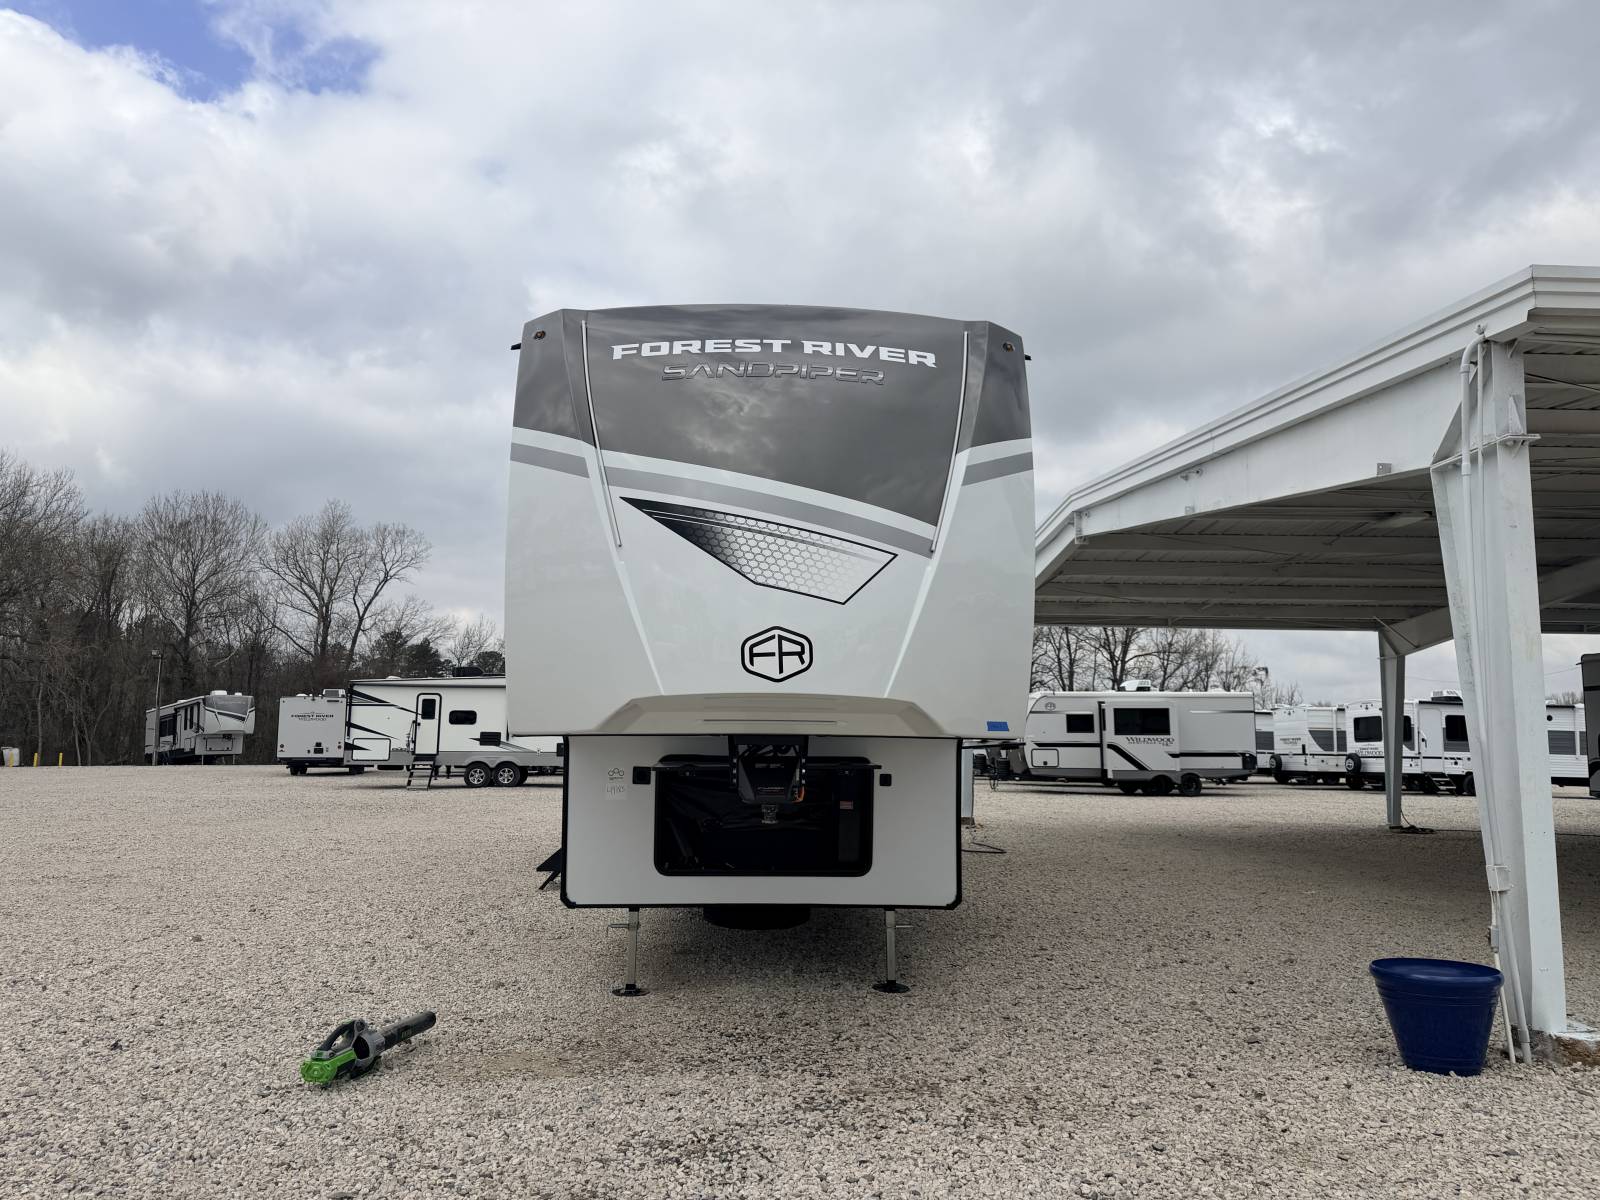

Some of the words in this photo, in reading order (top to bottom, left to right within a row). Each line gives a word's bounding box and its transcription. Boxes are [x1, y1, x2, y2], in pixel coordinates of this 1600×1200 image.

[611, 339, 792, 360] FOREST
[800, 340, 937, 368] RIVER
[661, 361, 885, 385] SANDPIPER
